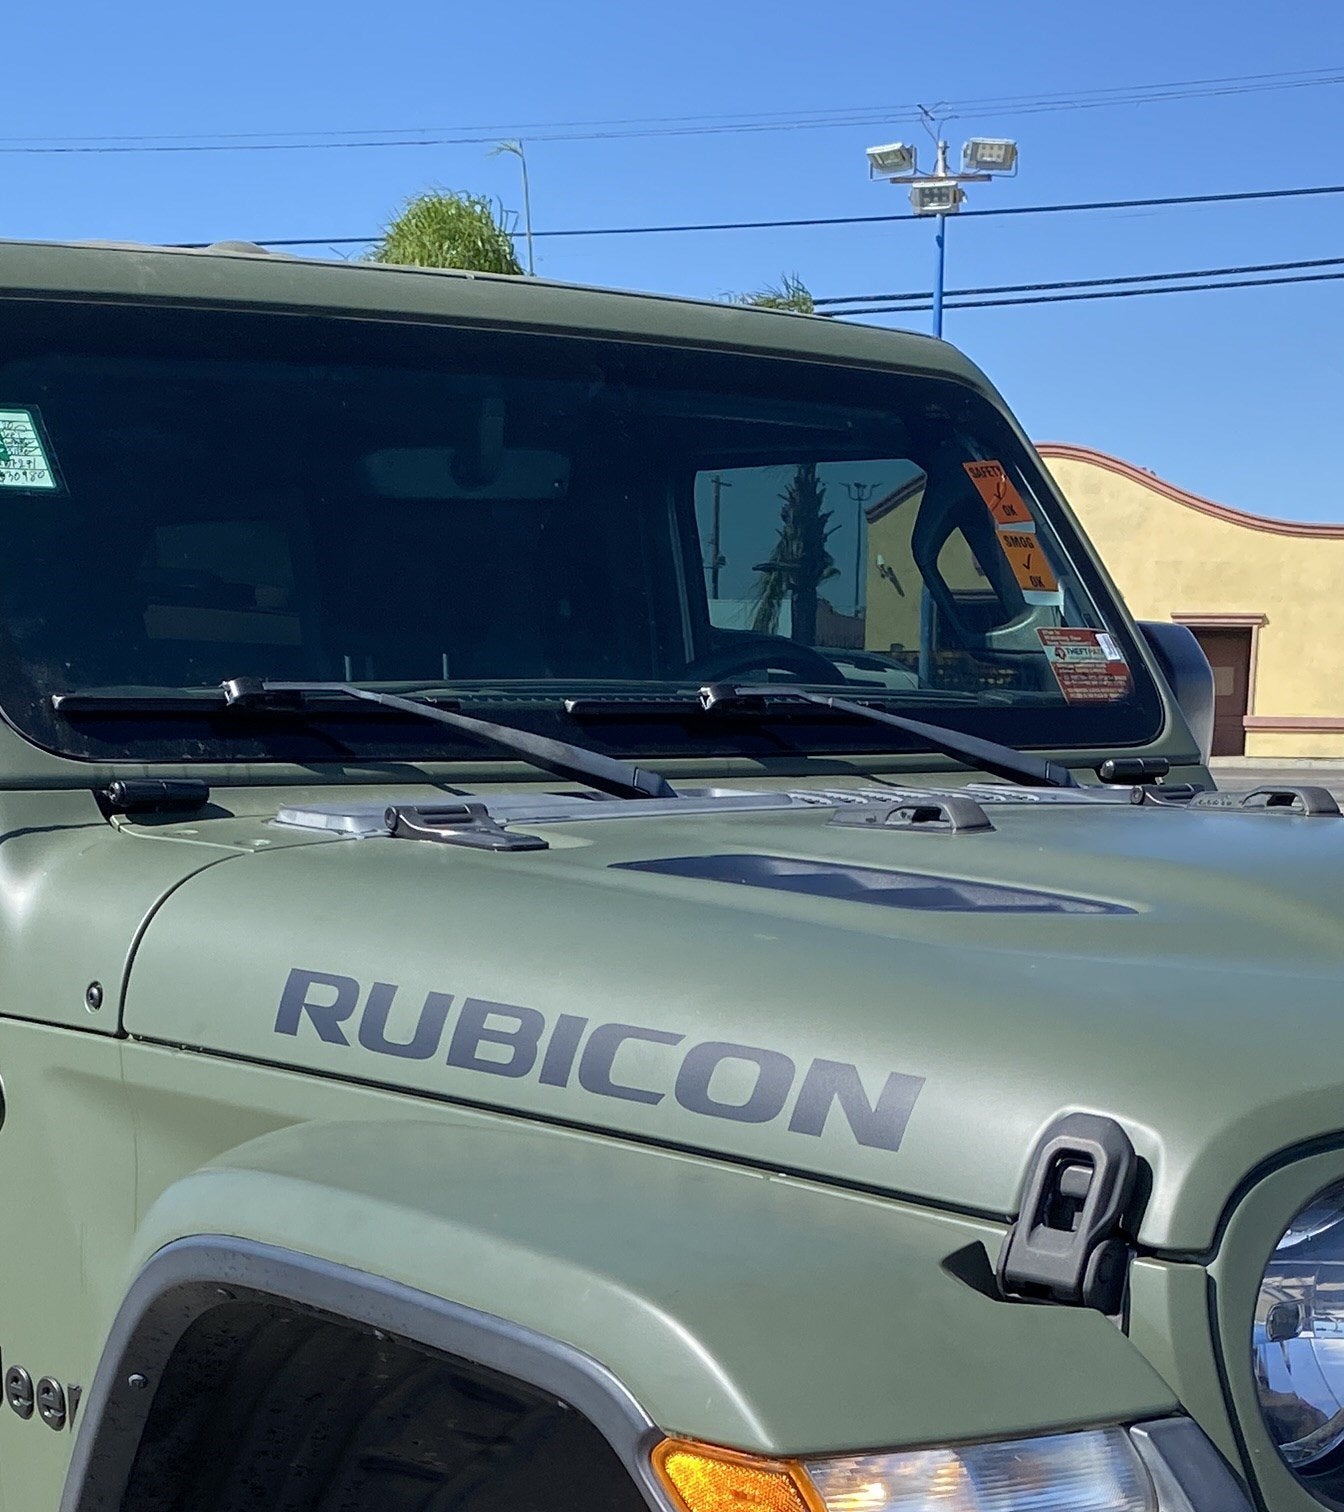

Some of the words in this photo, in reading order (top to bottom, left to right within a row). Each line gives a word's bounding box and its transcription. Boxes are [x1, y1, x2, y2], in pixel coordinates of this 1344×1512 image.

[968, 465, 1002, 478] SAFETY
[1002, 505, 1018, 516] OK
[1003, 535, 1035, 548] SMOG
[1029, 575, 1045, 588] OK
[273, 967, 926, 1152] RUBICON
